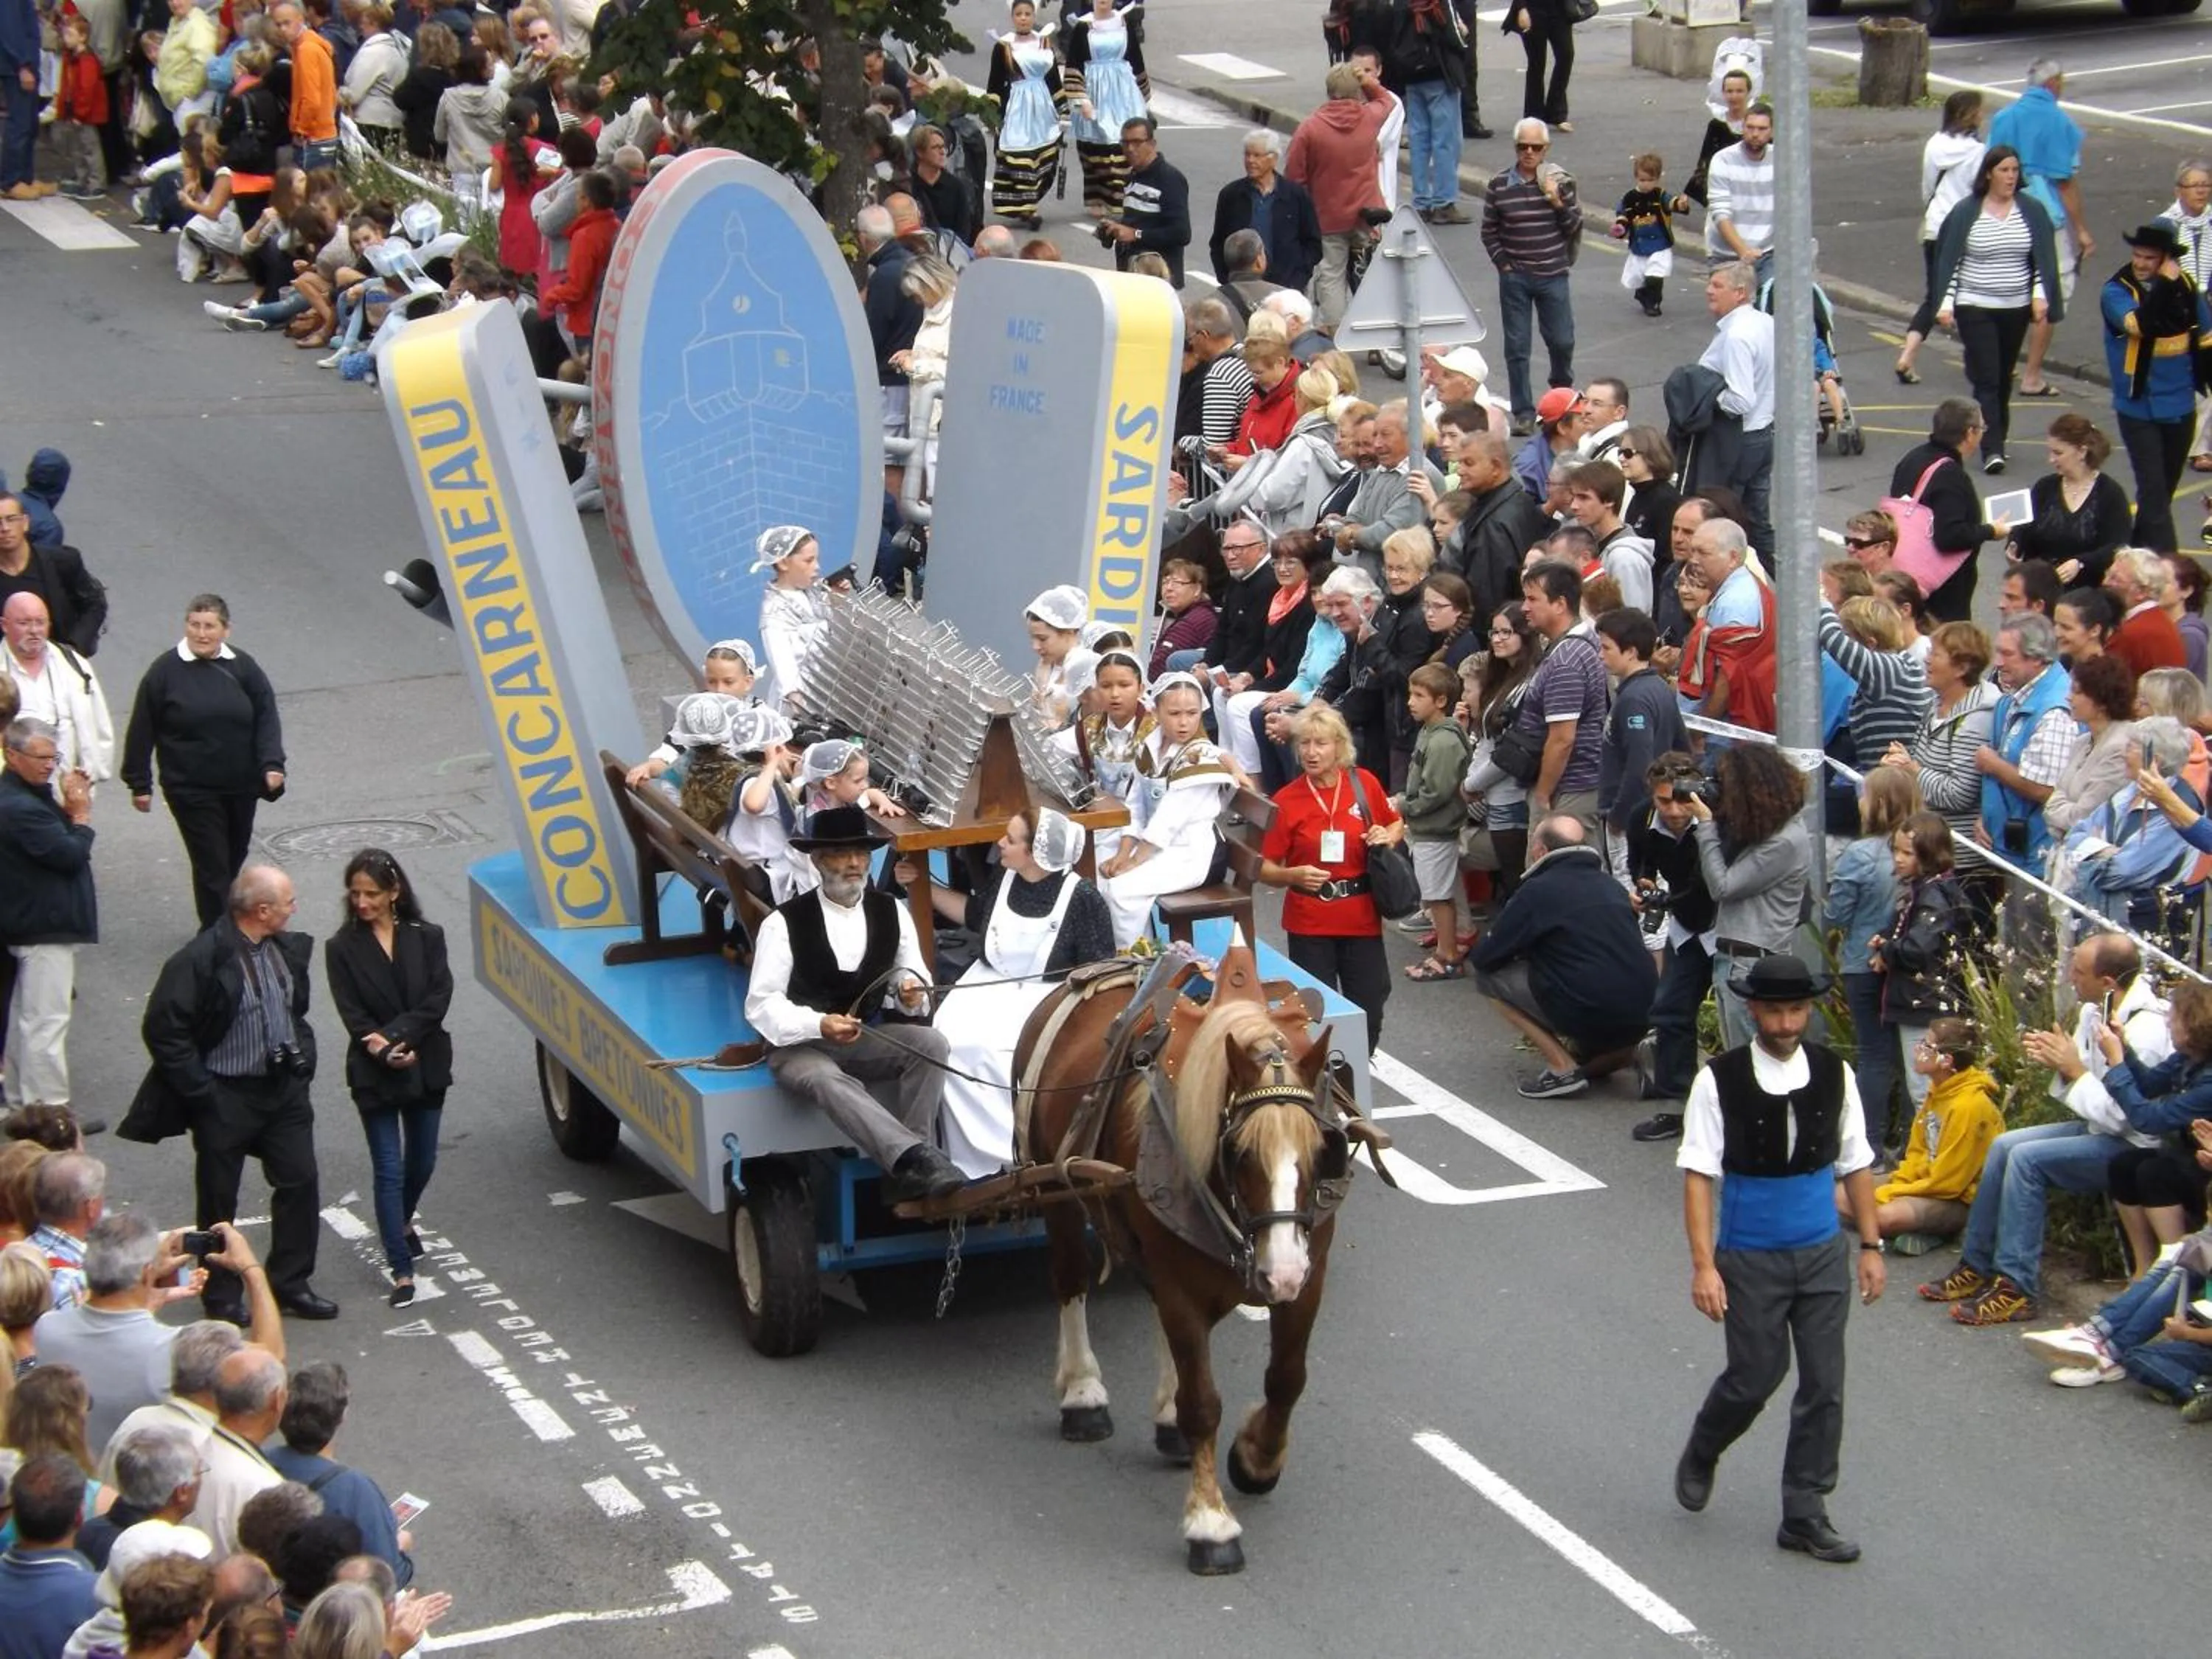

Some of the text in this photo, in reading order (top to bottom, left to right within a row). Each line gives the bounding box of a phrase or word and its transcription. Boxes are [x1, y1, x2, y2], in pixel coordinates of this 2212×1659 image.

[1006, 316, 1045, 344] MADE
[1014, 351, 1029, 376] IN
[990, 385, 1046, 415] FRANCE
[1093, 402, 1159, 625] SARDI
[410, 398, 612, 920] CONCARNEAU
[411, 1210, 571, 1363] REGLEMENT
